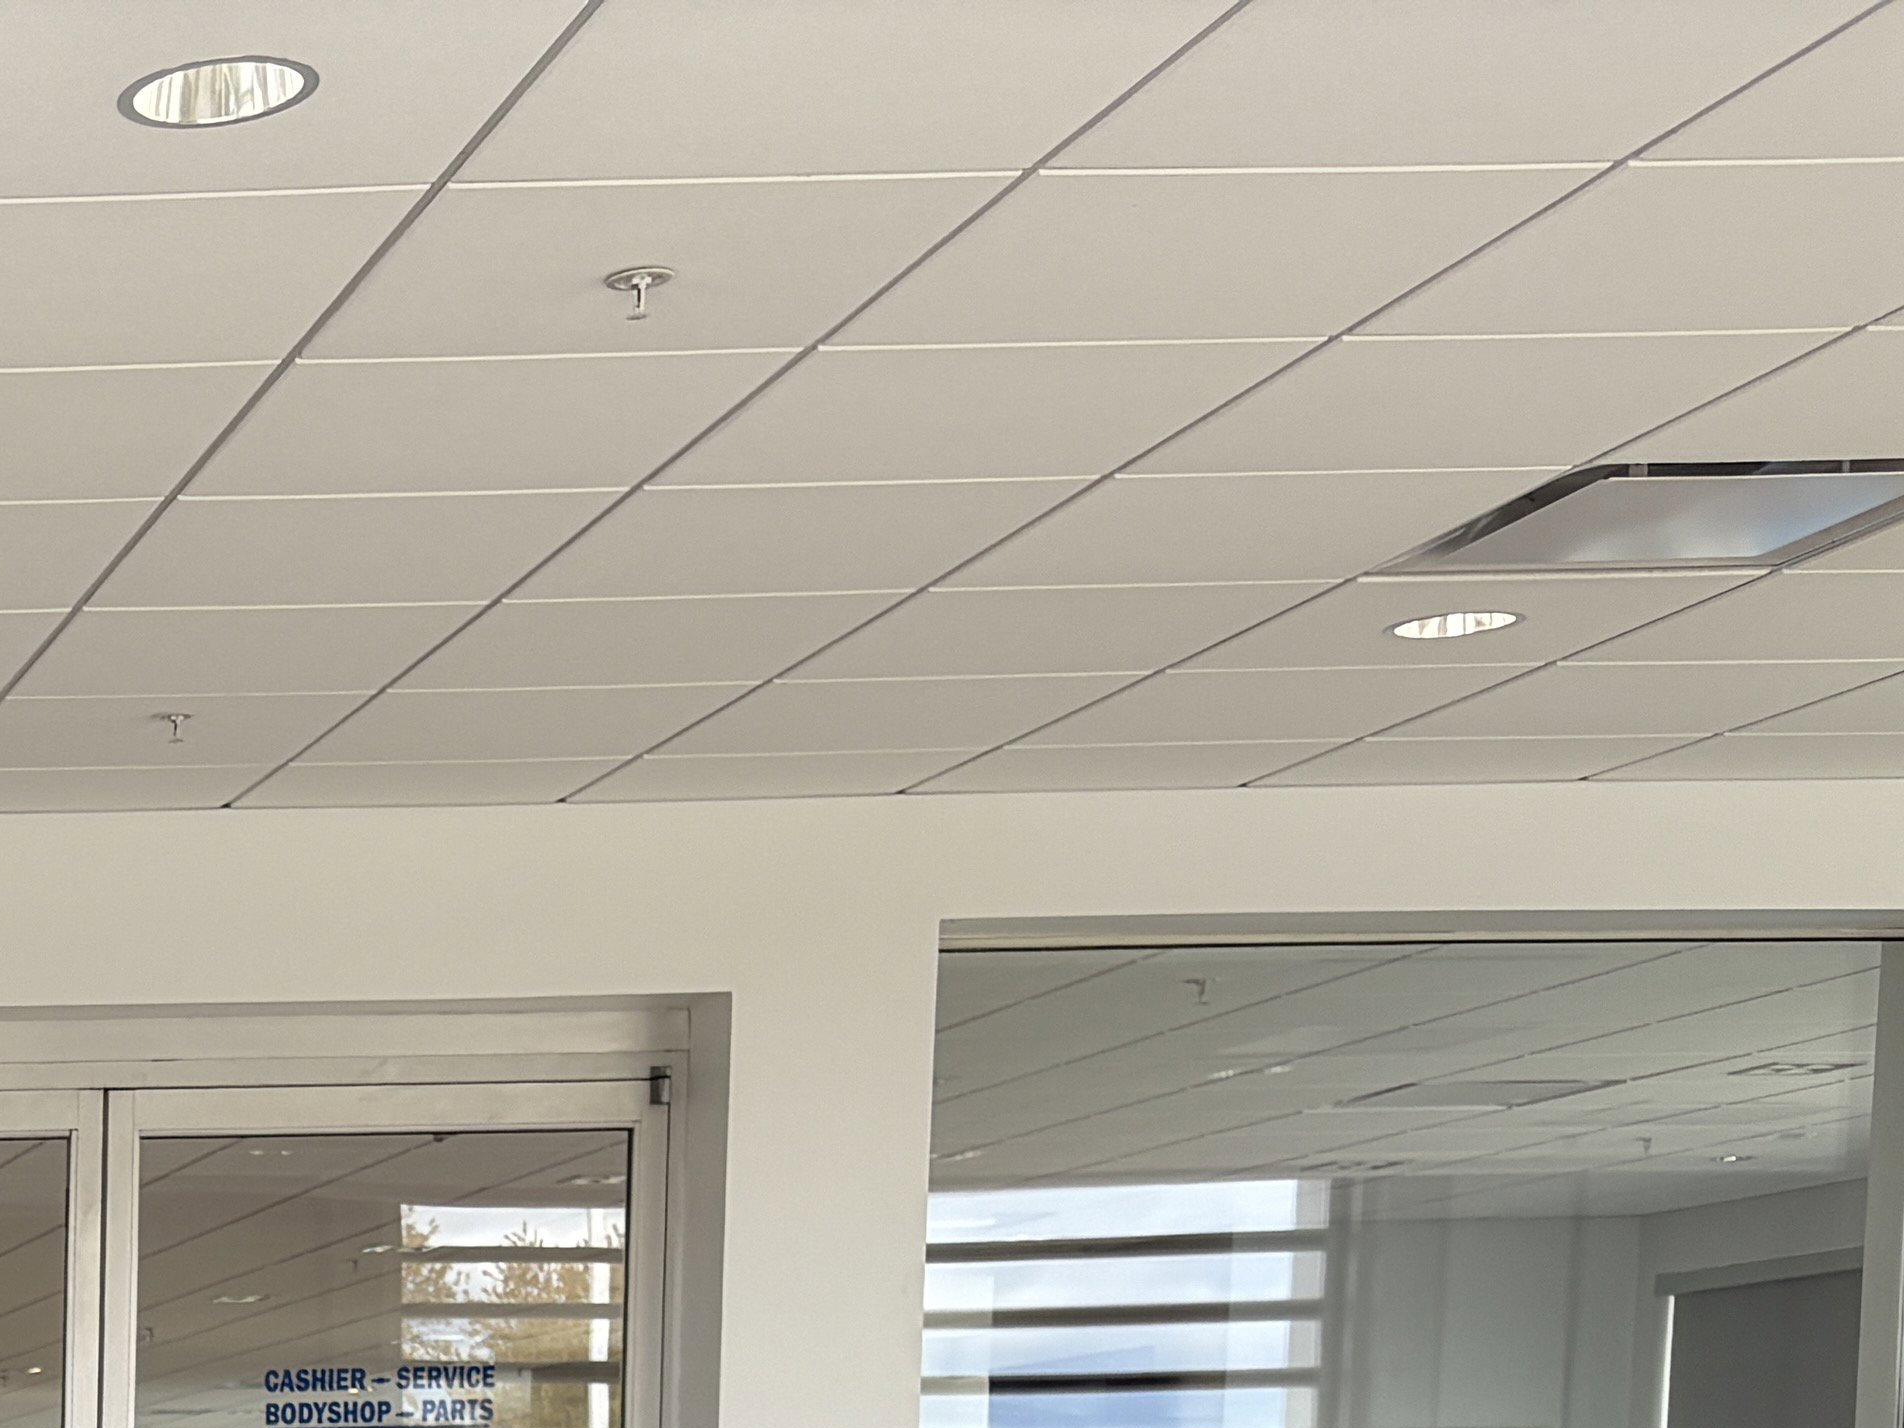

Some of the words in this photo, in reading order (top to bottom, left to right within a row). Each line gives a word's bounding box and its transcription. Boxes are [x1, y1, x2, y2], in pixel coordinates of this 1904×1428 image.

[264, 1368, 366, 1393] CASHIER
[396, 1365, 496, 1389] SERVICE
[265, 1401, 392, 1425] BODYSHOP
[421, 1398, 494, 1422] PARTS
